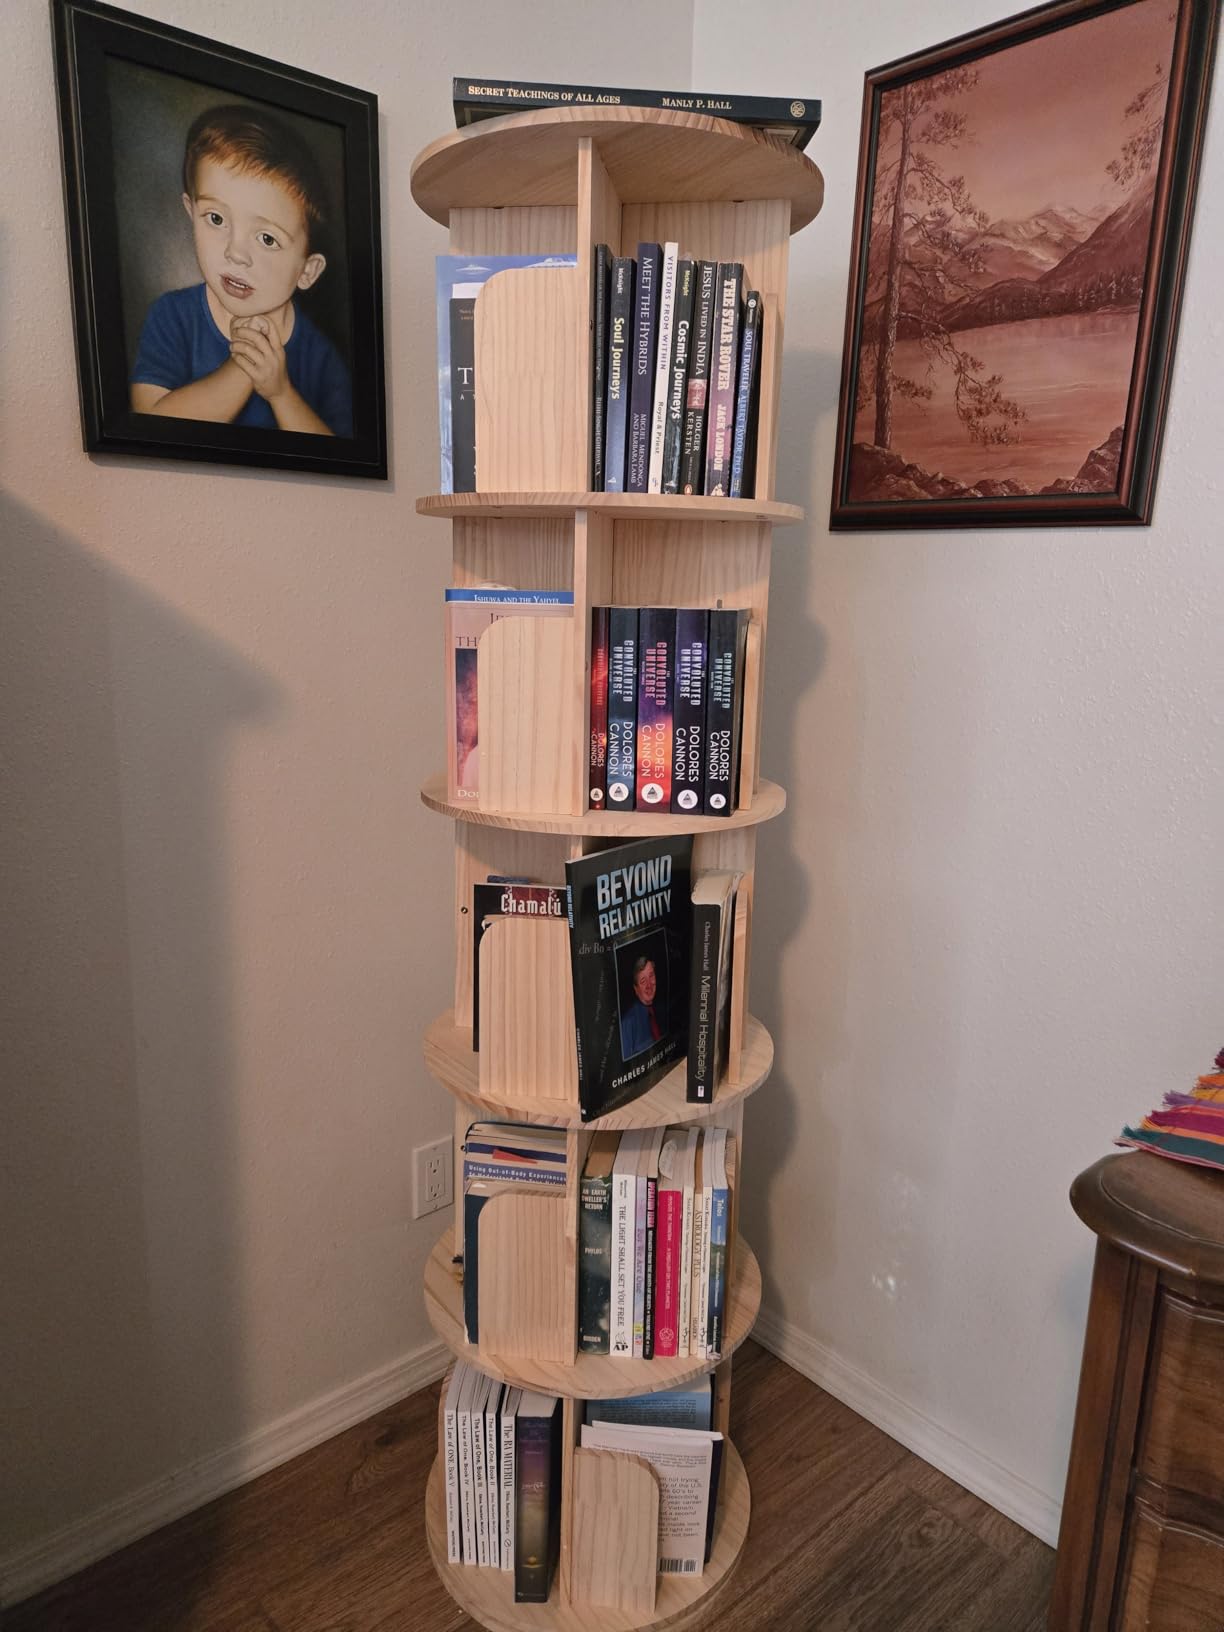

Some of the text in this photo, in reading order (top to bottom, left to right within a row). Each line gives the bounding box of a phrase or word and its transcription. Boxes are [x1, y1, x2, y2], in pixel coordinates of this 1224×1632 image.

[468, 86, 621, 104] SECRET TEACHINGS OF ALL AGES
[662, 97, 732, 110] MANLY P. HALL
[638, 257, 653, 375] MEET THE HYBRIDS
[660, 256, 674, 370] VISITORS FROM WITHIN
[695, 265, 713, 375] JESUS LIVED IN INDIA
[717, 278, 736, 390] THE STAR ROVER
[610, 317, 625, 400] Soul Journeys
[744, 330, 753, 352] SOUL
[670, 320, 689, 419] Cosmic Journeys
[740, 354, 751, 391] TRAVELER
[639, 414, 647, 441] MIGUEL
[684, 411, 694, 455] KERSTEN
[693, 415, 702, 451] HOLGER
[713, 404, 726, 471] JACK LONDON
[735, 393, 747, 453] ALBERT TAYLOR
[612, 646, 623, 695] UNIVERSE
[622, 640, 634, 702] CONVOLUTED
[645, 648, 656, 698] UNIVERSE
[656, 642, 667, 706] CONVOLUTED
[679, 648, 691, 698] UNIVERSE
[690, 642, 702, 706] CONVOLUTED
[713, 658, 723, 702] UNIVERSE
[722, 652, 732, 709] CONVOLUTED
[590, 733, 598, 766] CANNON
[597, 732, 605, 767] DOLORES
[609, 723, 620, 775] CANNON
[622, 721, 633, 777] DOLORES
[641, 725, 651, 777] CANNON
[655, 723, 665, 779] DOLORES
[675, 728, 686, 780] CANNON
[688, 726, 700, 782] DOLORES
[709, 732, 720, 780] CANNON
[719, 730, 730, 782] DOLORES
[501, 893, 562, 916] Chamalú
[596, 854, 672, 911] BEYOND
[598, 889, 672, 940] RELATIVITY
[703, 921, 711, 942] Charles
[695, 975, 711, 1081] Millennial Hospitality
[612, 1064, 645, 1088] CHARLES
[647, 1052, 664, 1070] JAMES
[468, 1164, 486, 1173] Using
[488, 1166, 527, 1178] Out-of-Body
[618, 1205, 626, 1221] THE
[716, 1199, 724, 1217] Telos
[618, 1222, 626, 1245] LIGHT
[693, 1209, 703, 1278] ASTROLOGY PLUS
[618, 1246, 626, 1272] SHALL
[617, 1307, 625, 1327] FREE
[474, 1451, 482, 1465] One,
[503, 1424, 513, 1488] The RA MATERIAL
